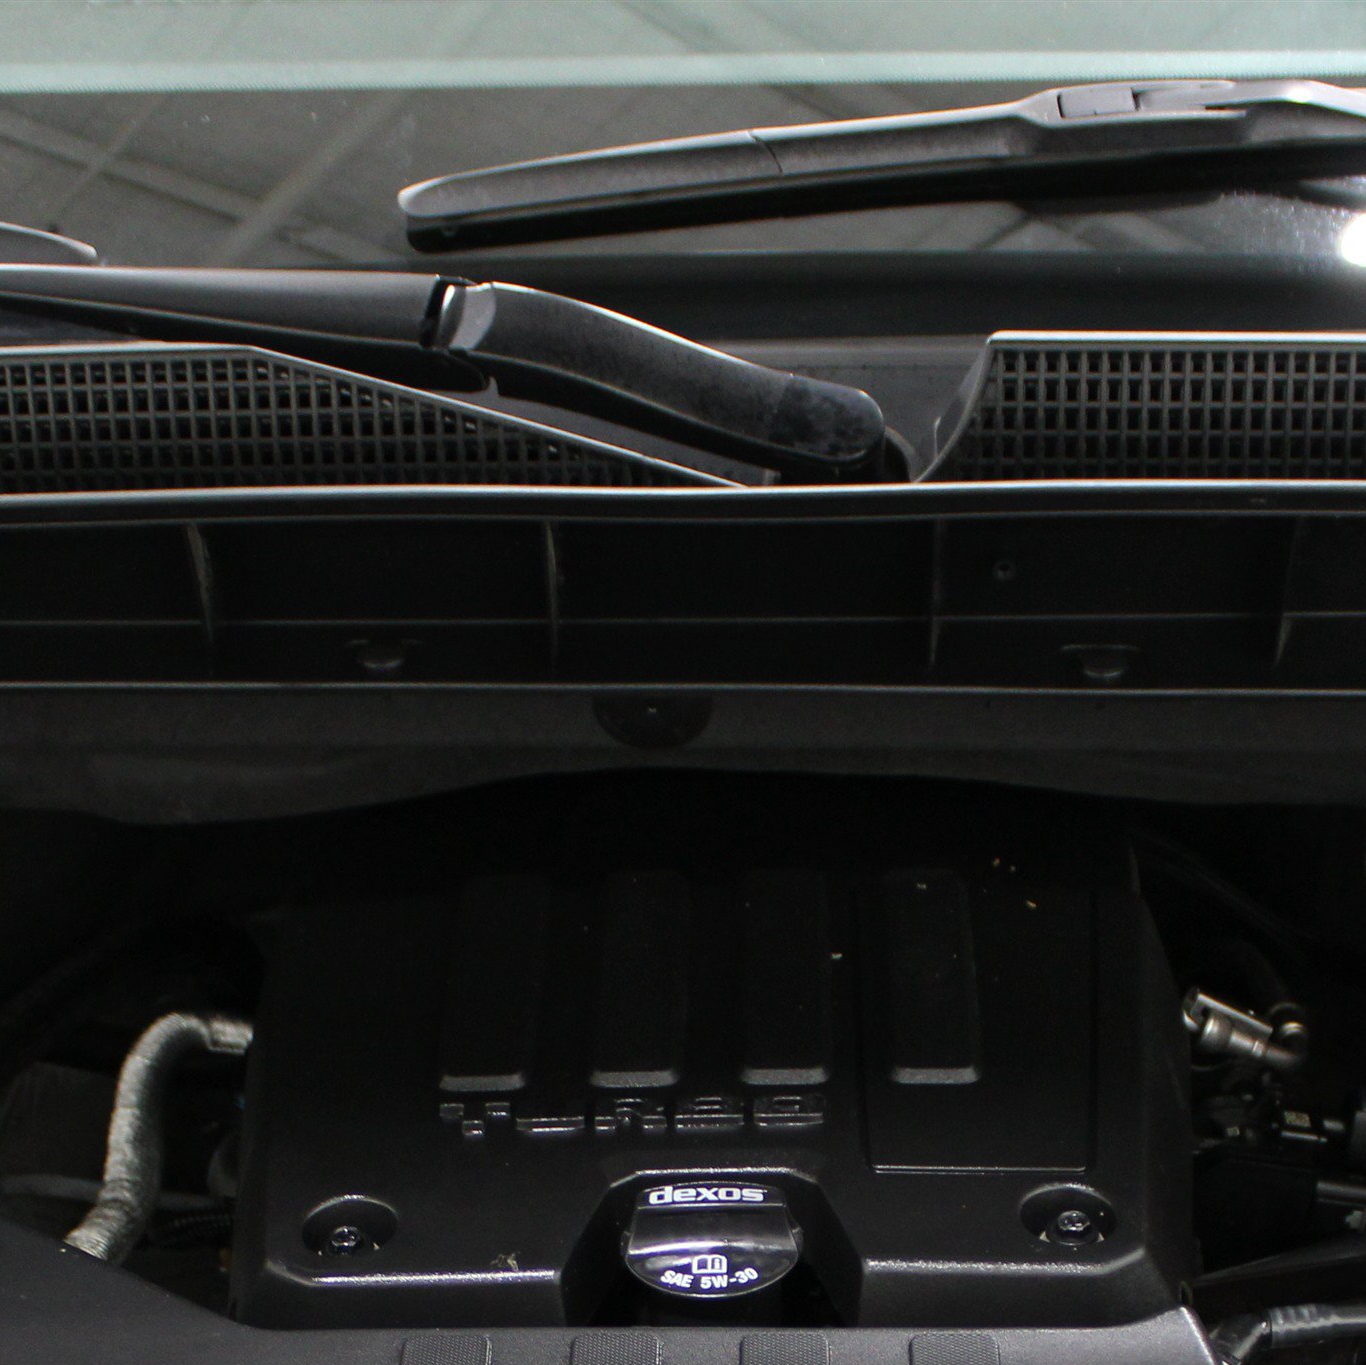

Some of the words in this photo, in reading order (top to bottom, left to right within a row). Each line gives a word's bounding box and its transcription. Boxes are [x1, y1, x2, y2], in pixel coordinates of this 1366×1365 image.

[648, 1186, 765, 1205] dexos
[660, 1269, 694, 1289] SAE
[700, 1267, 759, 1289] 5W-30
